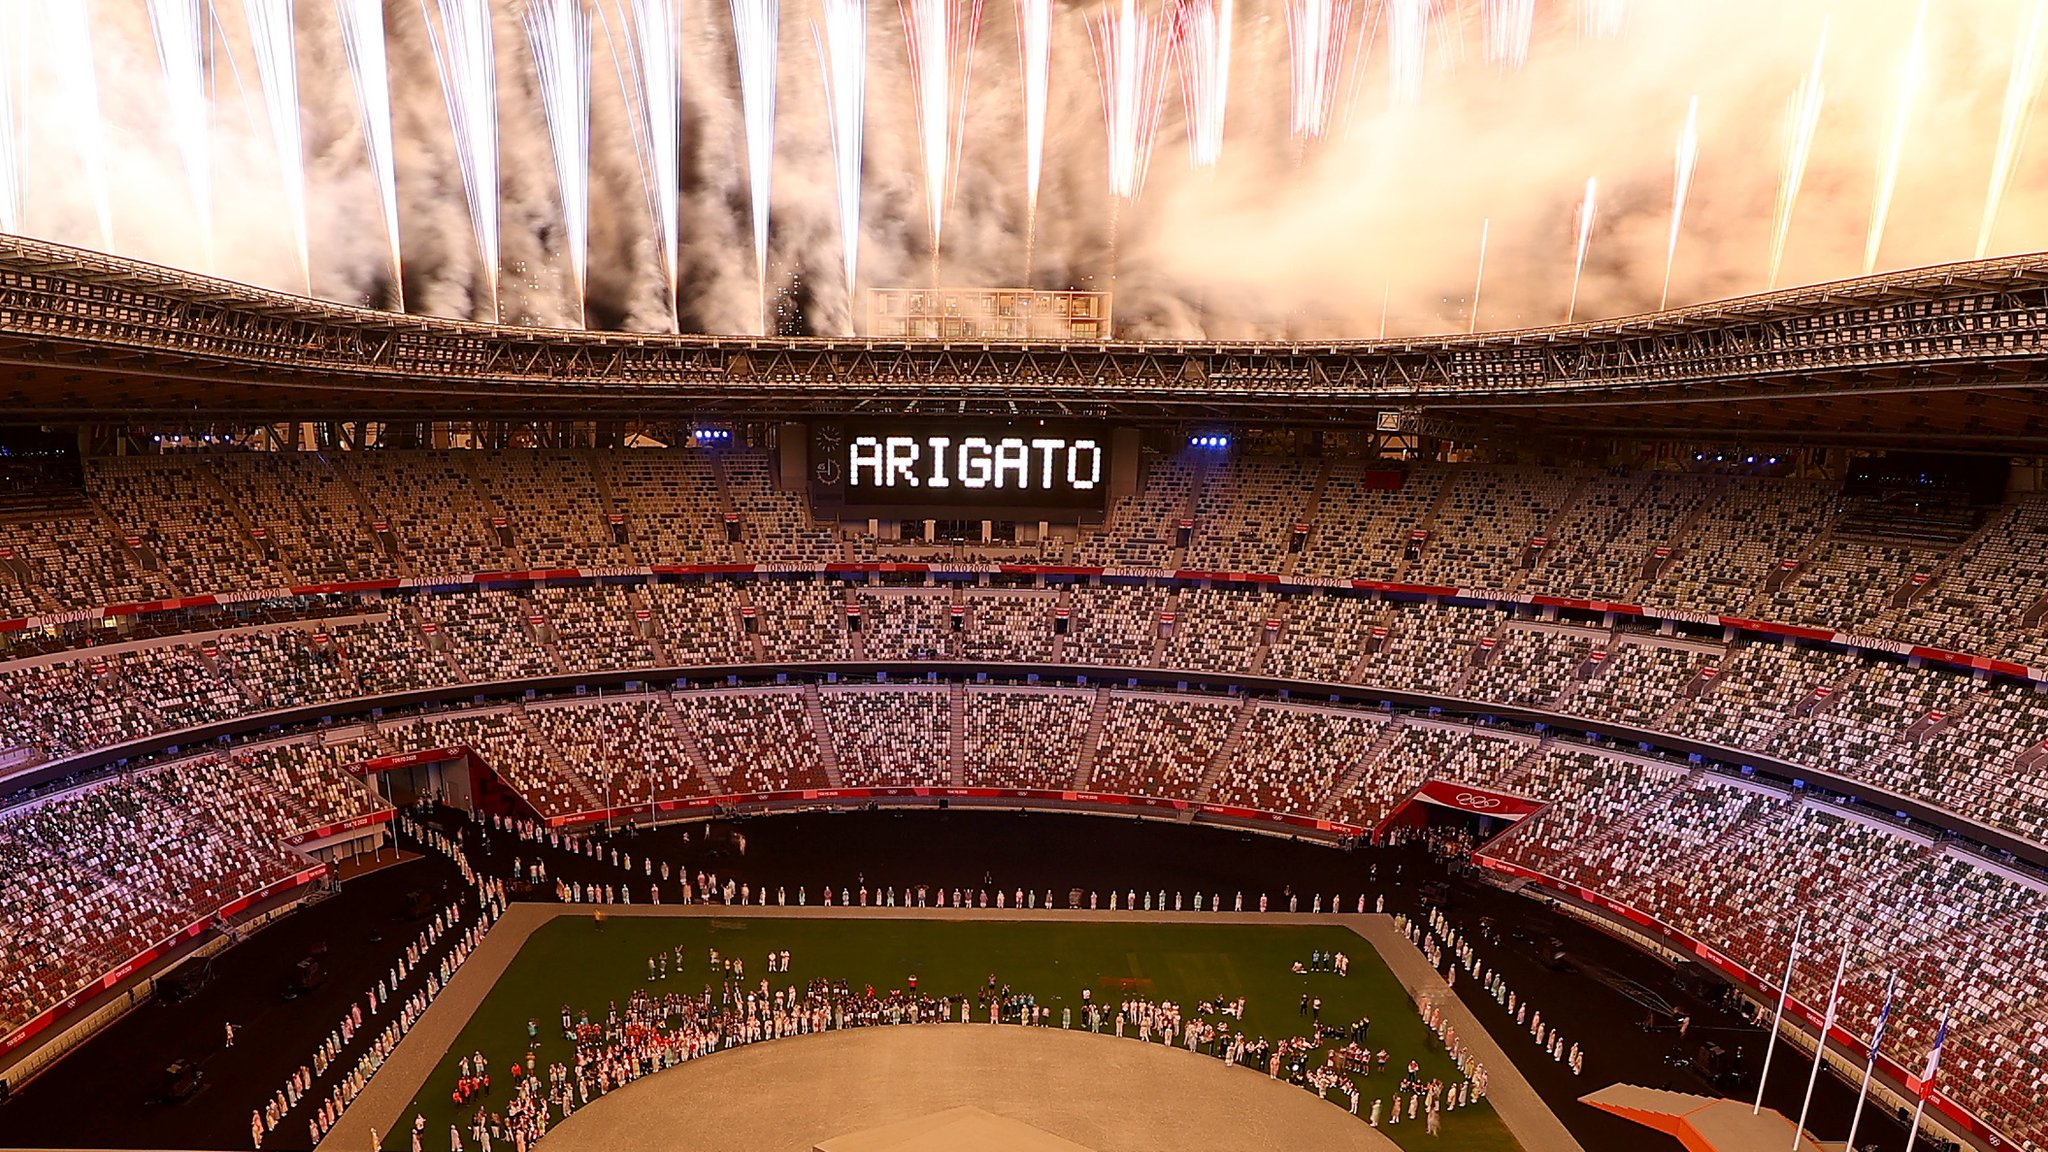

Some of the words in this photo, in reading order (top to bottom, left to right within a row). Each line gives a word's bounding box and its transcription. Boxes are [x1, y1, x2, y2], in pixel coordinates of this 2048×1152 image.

[850, 437, 1101, 489] ARIGATO
[592, 567, 618, 576] TOKYO
[620, 566, 641, 575] 2020
[766, 564, 793, 572] TOKYO
[796, 564, 816, 572] 2020
[941, 564, 967, 572] TOKYO
[969, 564, 990, 572] 2020
[1115, 567, 1143, 576] TOKYO
[1145, 568, 1165, 577] 2020
[412, 576, 439, 586] TOKYO
[442, 575, 462, 584] 2020
[1292, 577, 1319, 587] TOKYO
[1321, 579, 1341, 588] 2020
[227, 590, 256, 602] TOKYO
[259, 588, 280, 600] 2020
[1470, 590, 1498, 600] TOKYO
[1500, 592, 1521, 602] 2020
[40, 612, 68, 624] TOKYO
[70, 610, 93, 621] 2020
[1656, 609, 1684, 621] TOKYO
[1687, 612, 1708, 623] 2020
[1846, 635, 1876, 649] TOKYO
[1879, 640, 1900, 653] 2020
